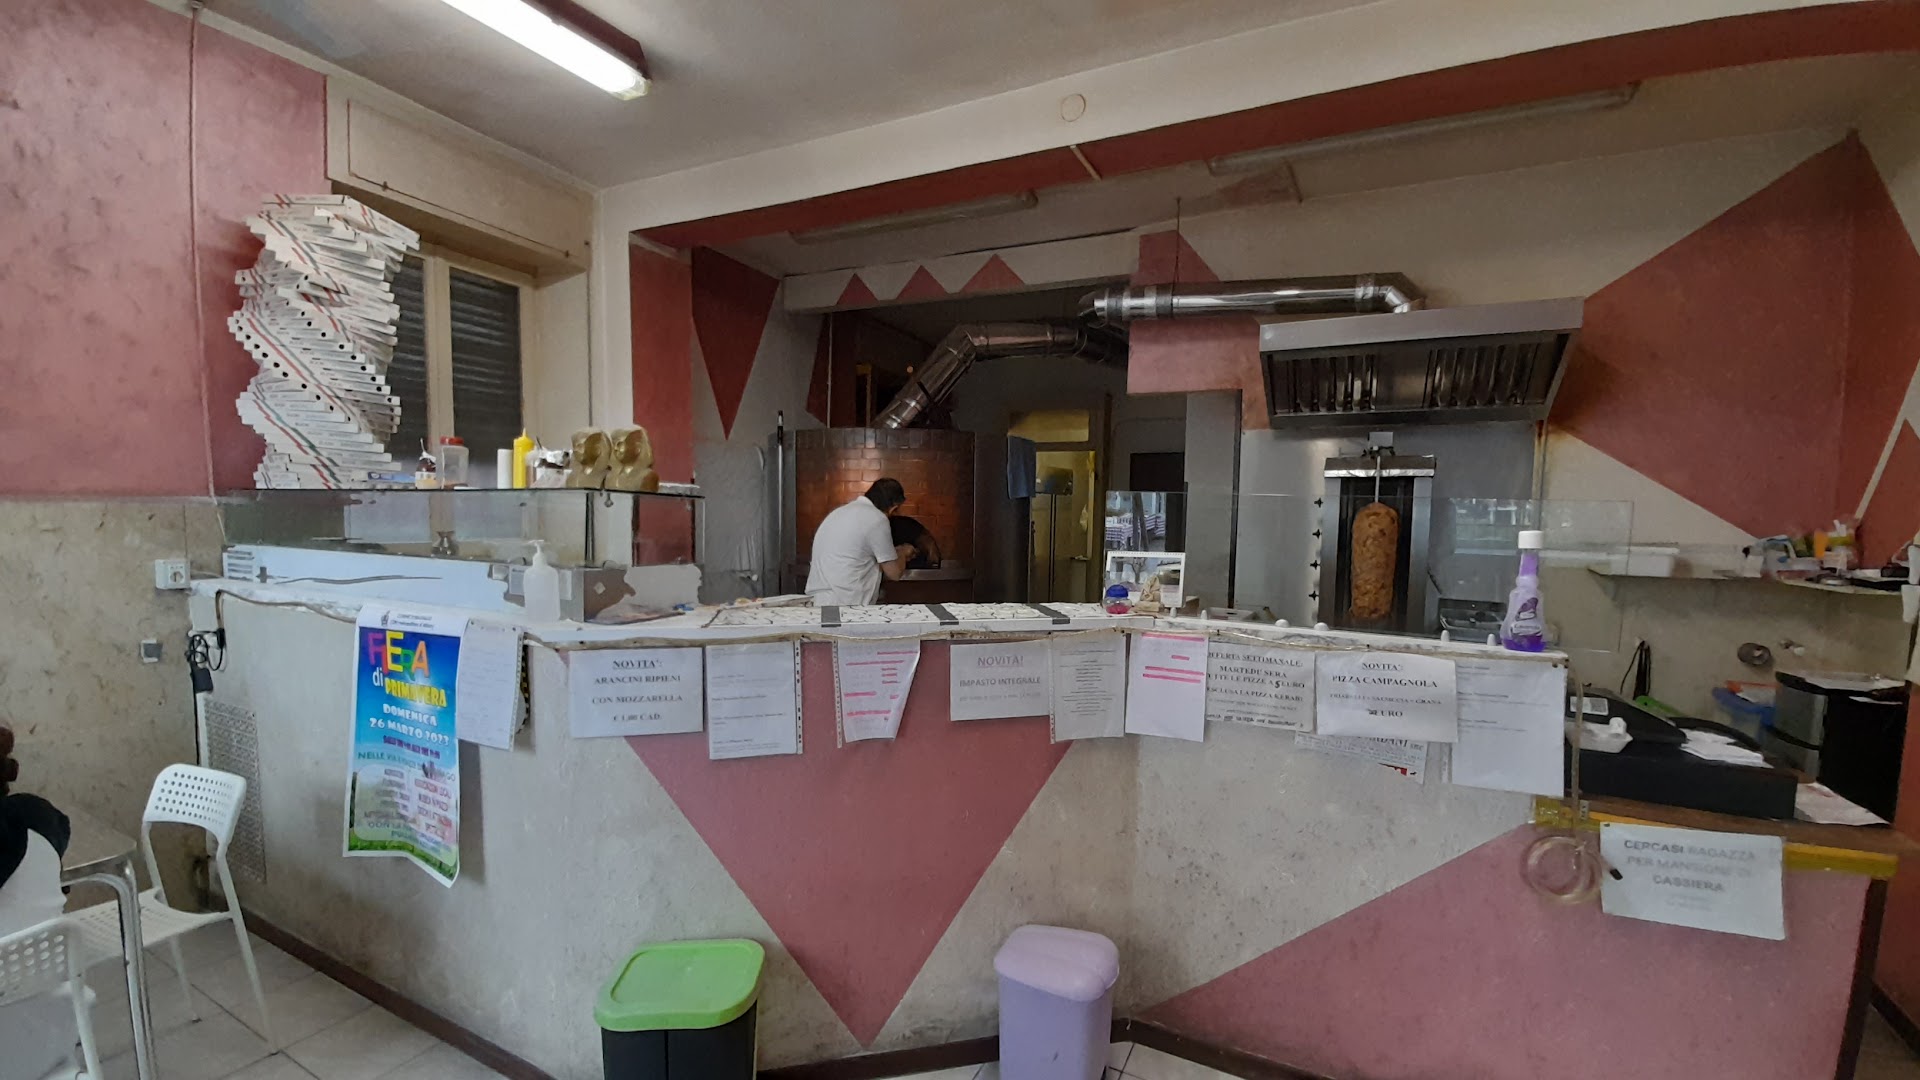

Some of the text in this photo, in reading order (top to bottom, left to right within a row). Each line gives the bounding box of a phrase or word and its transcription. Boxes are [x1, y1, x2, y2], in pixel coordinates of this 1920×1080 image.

[367, 630, 430, 681] FIERA
[372, 667, 384, 687] di
[594, 674, 681, 685] ARANCINI RIPIENI
[1243, 675, 1267, 685] PIZZE
[1264, 669, 1288, 679] SERA
[959, 676, 1042, 687] IMPASTO INTEGRALE
[1332, 675, 1438, 688] PIZZA CAMPAGNOLA
[384, 677, 448, 708] PRIMAVERA
[592, 694, 684, 704] CON MOZZARELLA
[1251, 690, 1273, 699] PIZZA
[383, 703, 438, 727] DOMENICA
[369, 717, 450, 746] 26 MARZO 2023
[1623, 839, 1757, 861] CERCASI RAGAZZA
[1626, 856, 1655, 867] PER
[1652, 874, 1727, 892] CASSIERA
